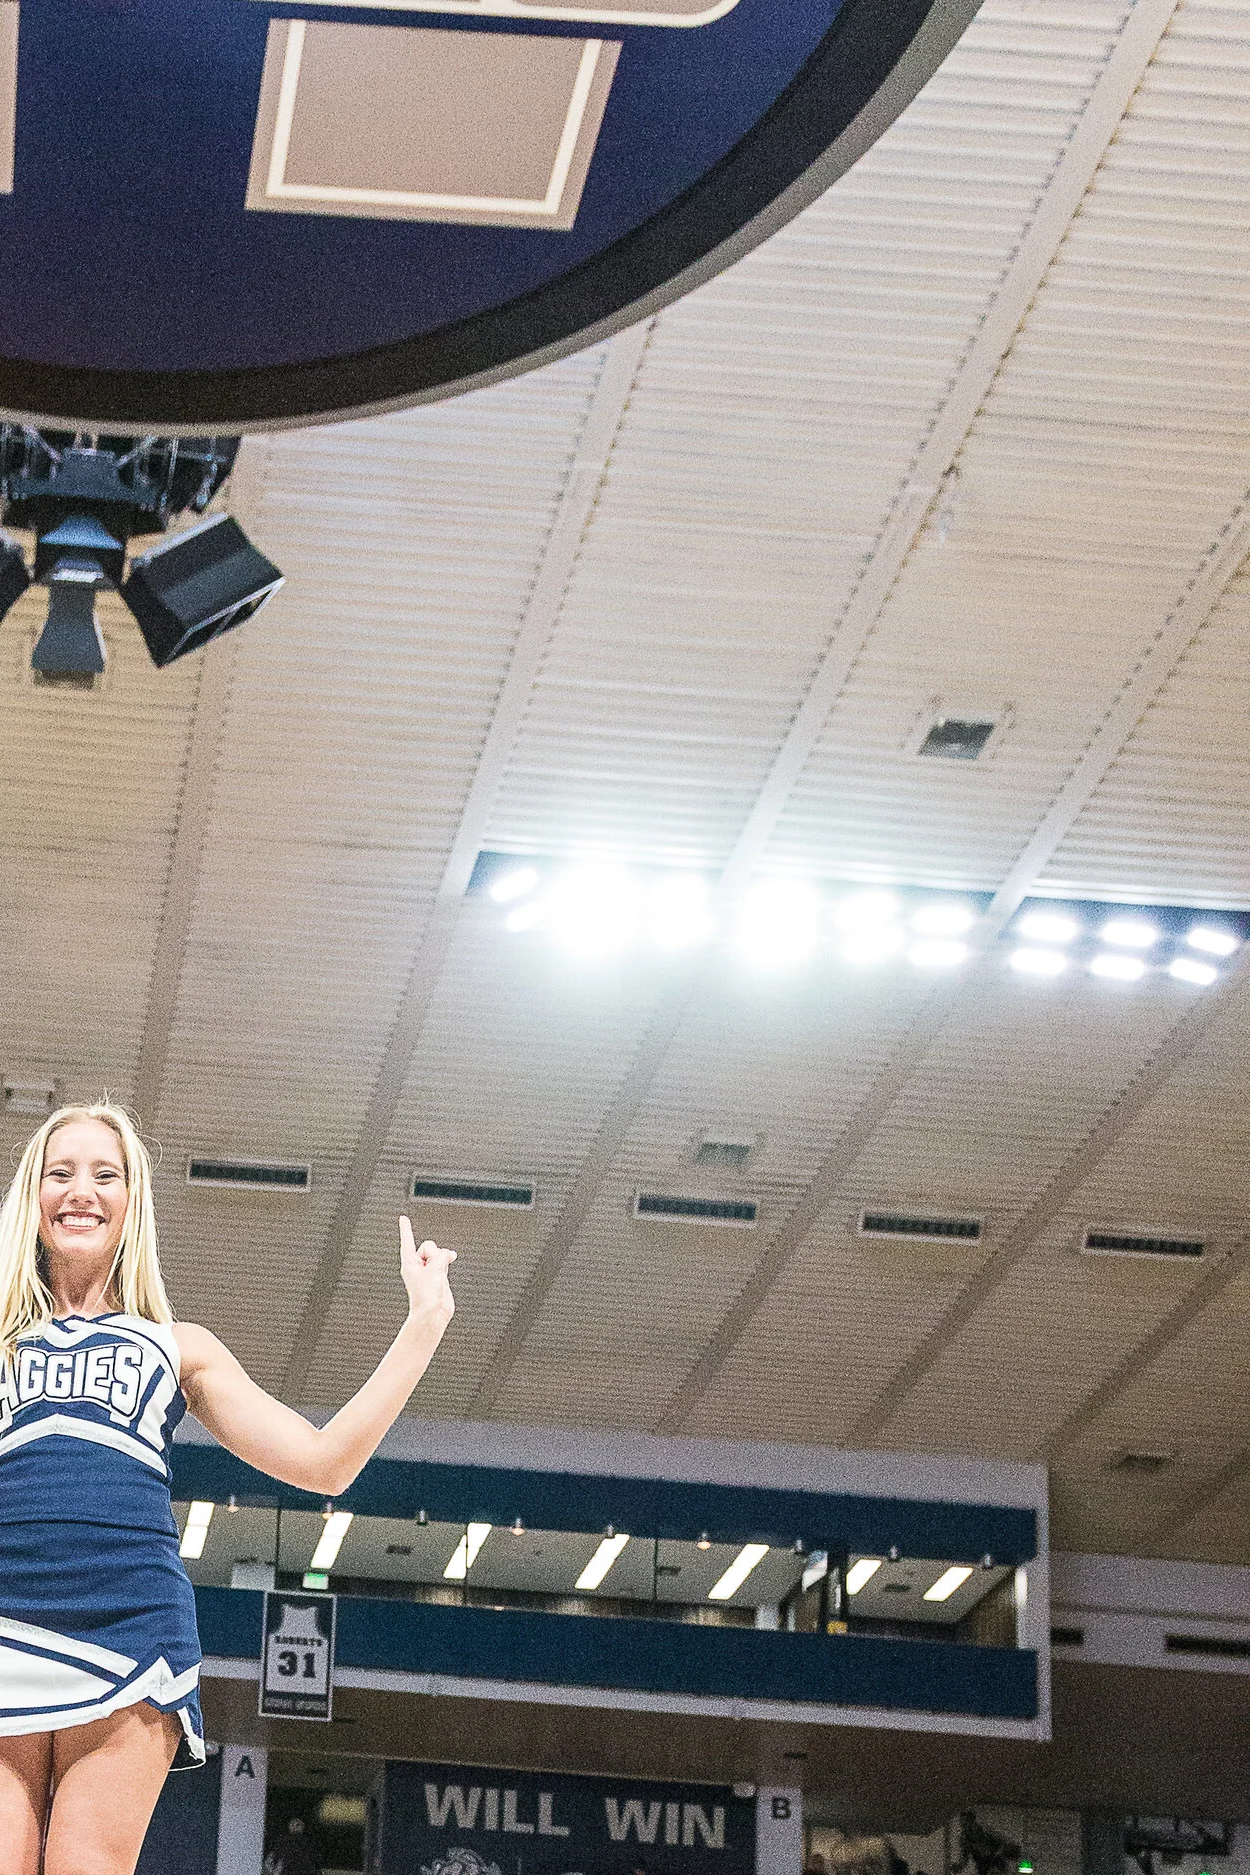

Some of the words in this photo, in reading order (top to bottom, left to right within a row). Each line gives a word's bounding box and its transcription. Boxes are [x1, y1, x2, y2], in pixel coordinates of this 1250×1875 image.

[277, 1651, 316, 1678] 31
[235, 1755, 255, 1779] A
[424, 1783, 570, 1837] WILL
[605, 1798, 725, 1848] WIN
[771, 1797, 791, 1820] B
